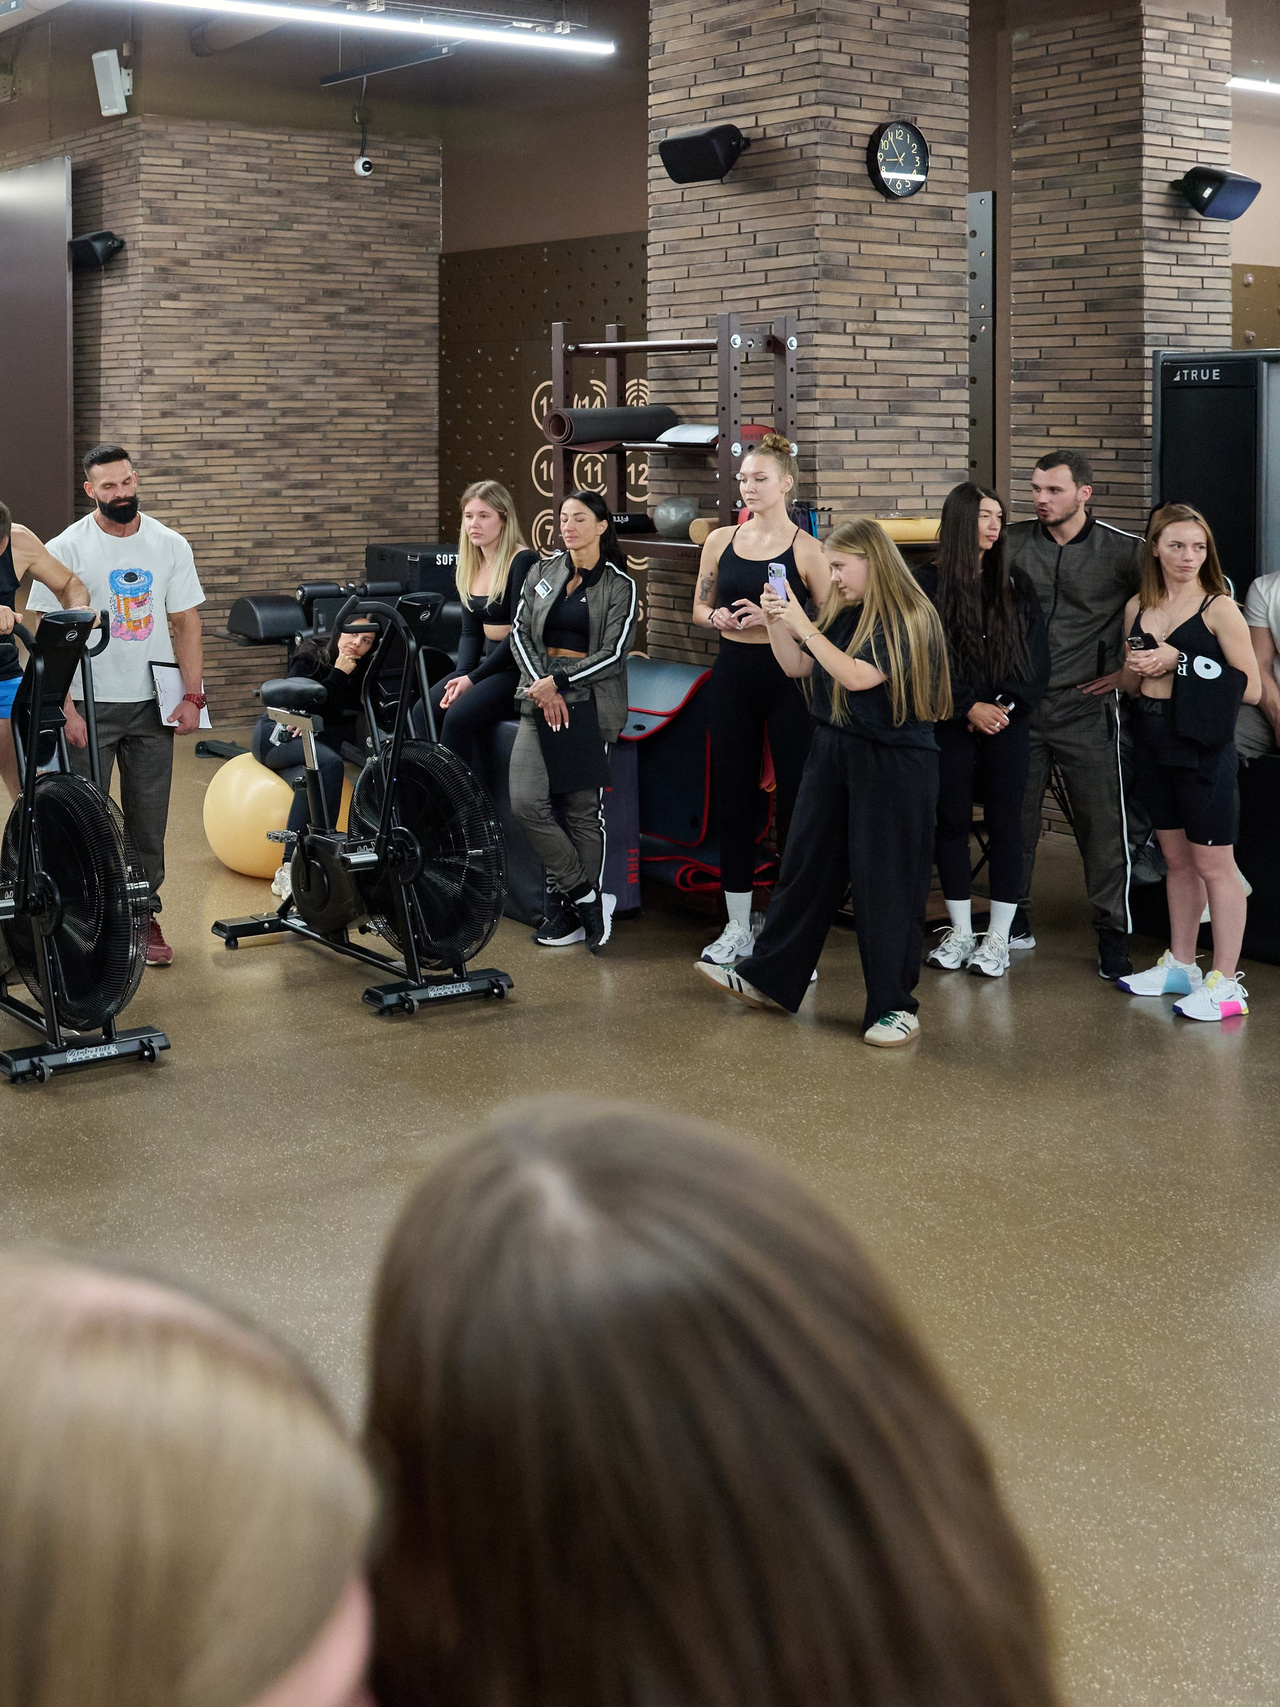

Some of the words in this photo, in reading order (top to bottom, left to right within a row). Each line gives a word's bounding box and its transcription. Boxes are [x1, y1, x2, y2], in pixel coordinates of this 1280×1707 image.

[896, 129, 904, 140] 12
[907, 133, 910, 144] 1
[881, 140, 889, 150] 10
[911, 143, 918, 154] 2
[877, 152, 884, 163] 9
[915, 156, 920, 167] 3
[896, 180, 902, 190] 6
[905, 179, 911, 188] 5
[1182, 369, 1221, 381] TRUE
[539, 461, 553, 481] 1
[583, 461, 602, 484] 11
[626, 462, 649, 486] 12
[435, 553, 460, 566] SOFT
[626, 848, 640, 884] FIRM
